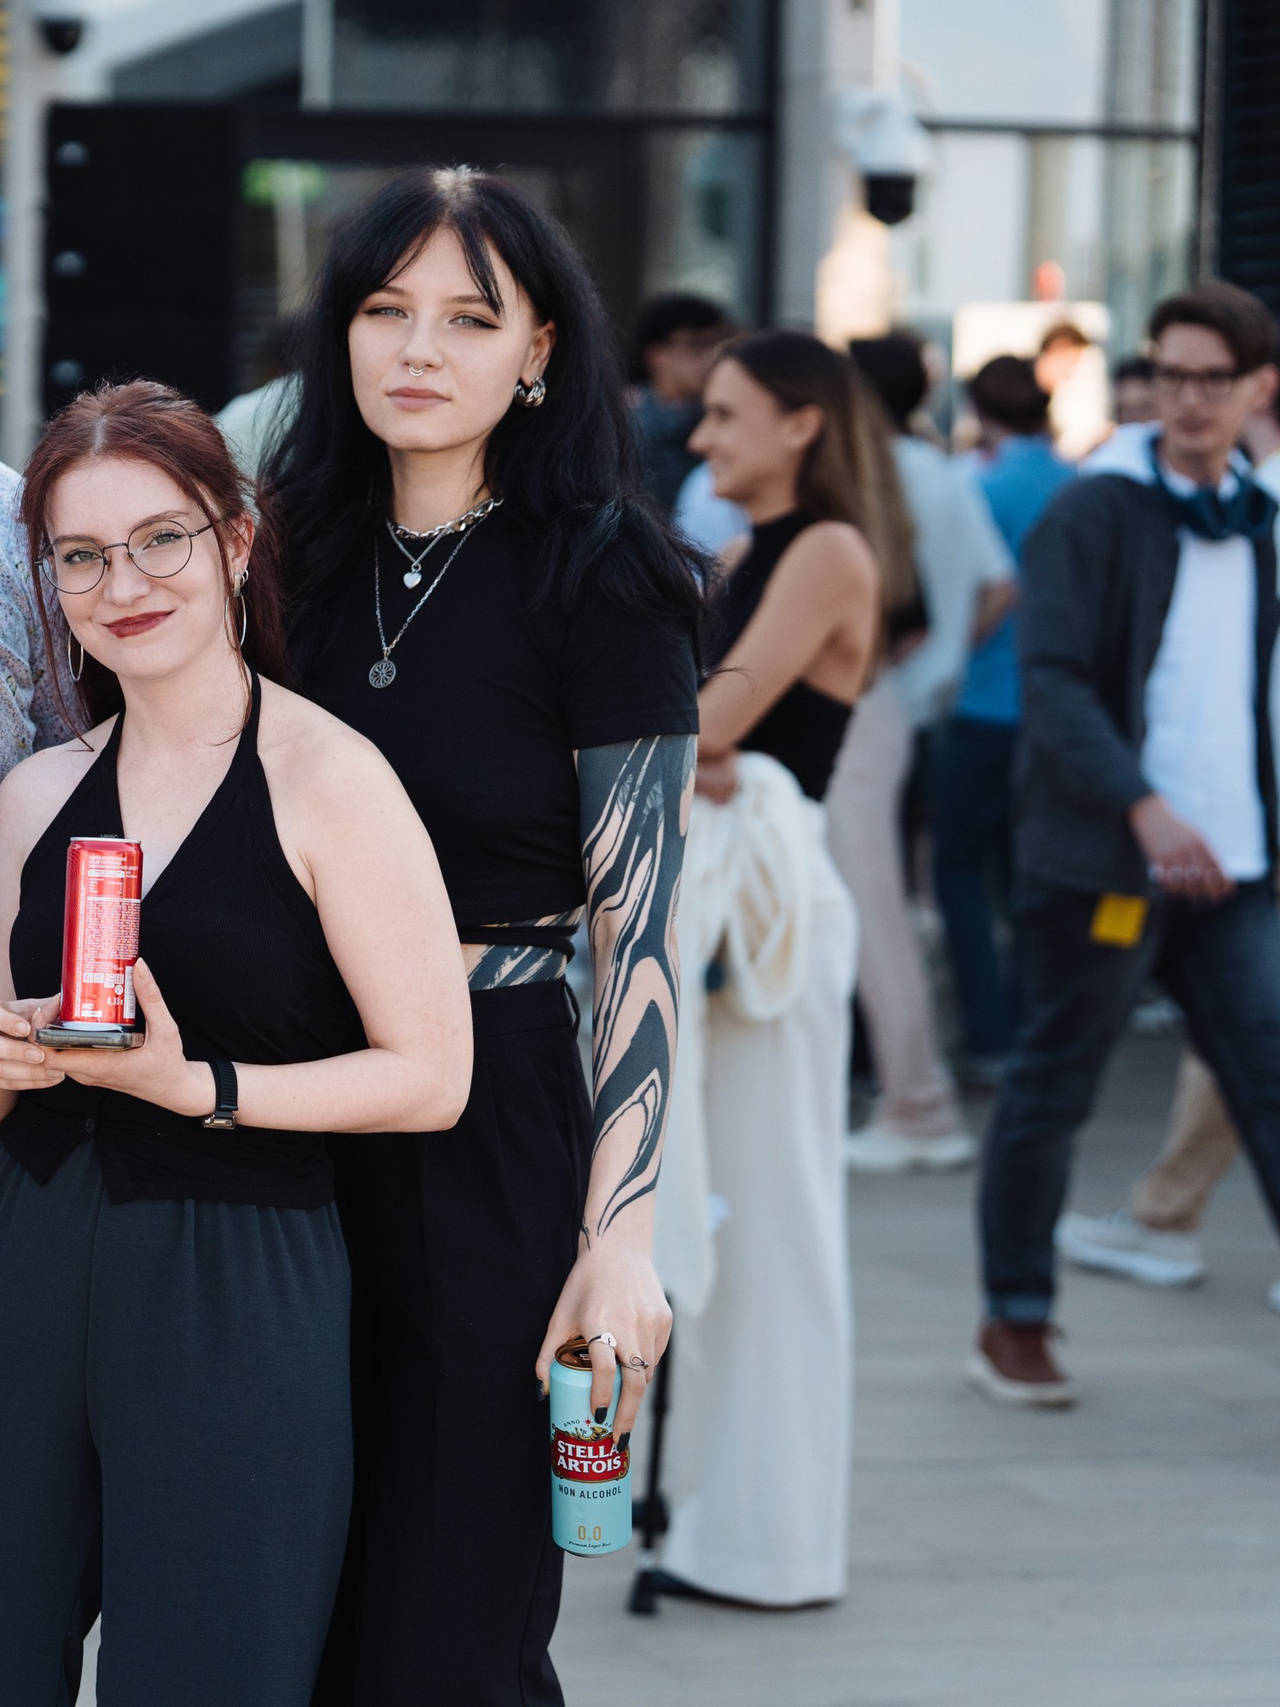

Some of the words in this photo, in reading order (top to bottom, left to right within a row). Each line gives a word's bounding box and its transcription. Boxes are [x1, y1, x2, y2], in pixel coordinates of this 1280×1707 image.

[557, 1440, 620, 1459] STELLA
[557, 1454, 622, 1473] ARTOIS
[558, 1484, 576, 1497] NON
[579, 1485, 622, 1499] ALCOHOL
[578, 1525, 602, 1541] 0.0
